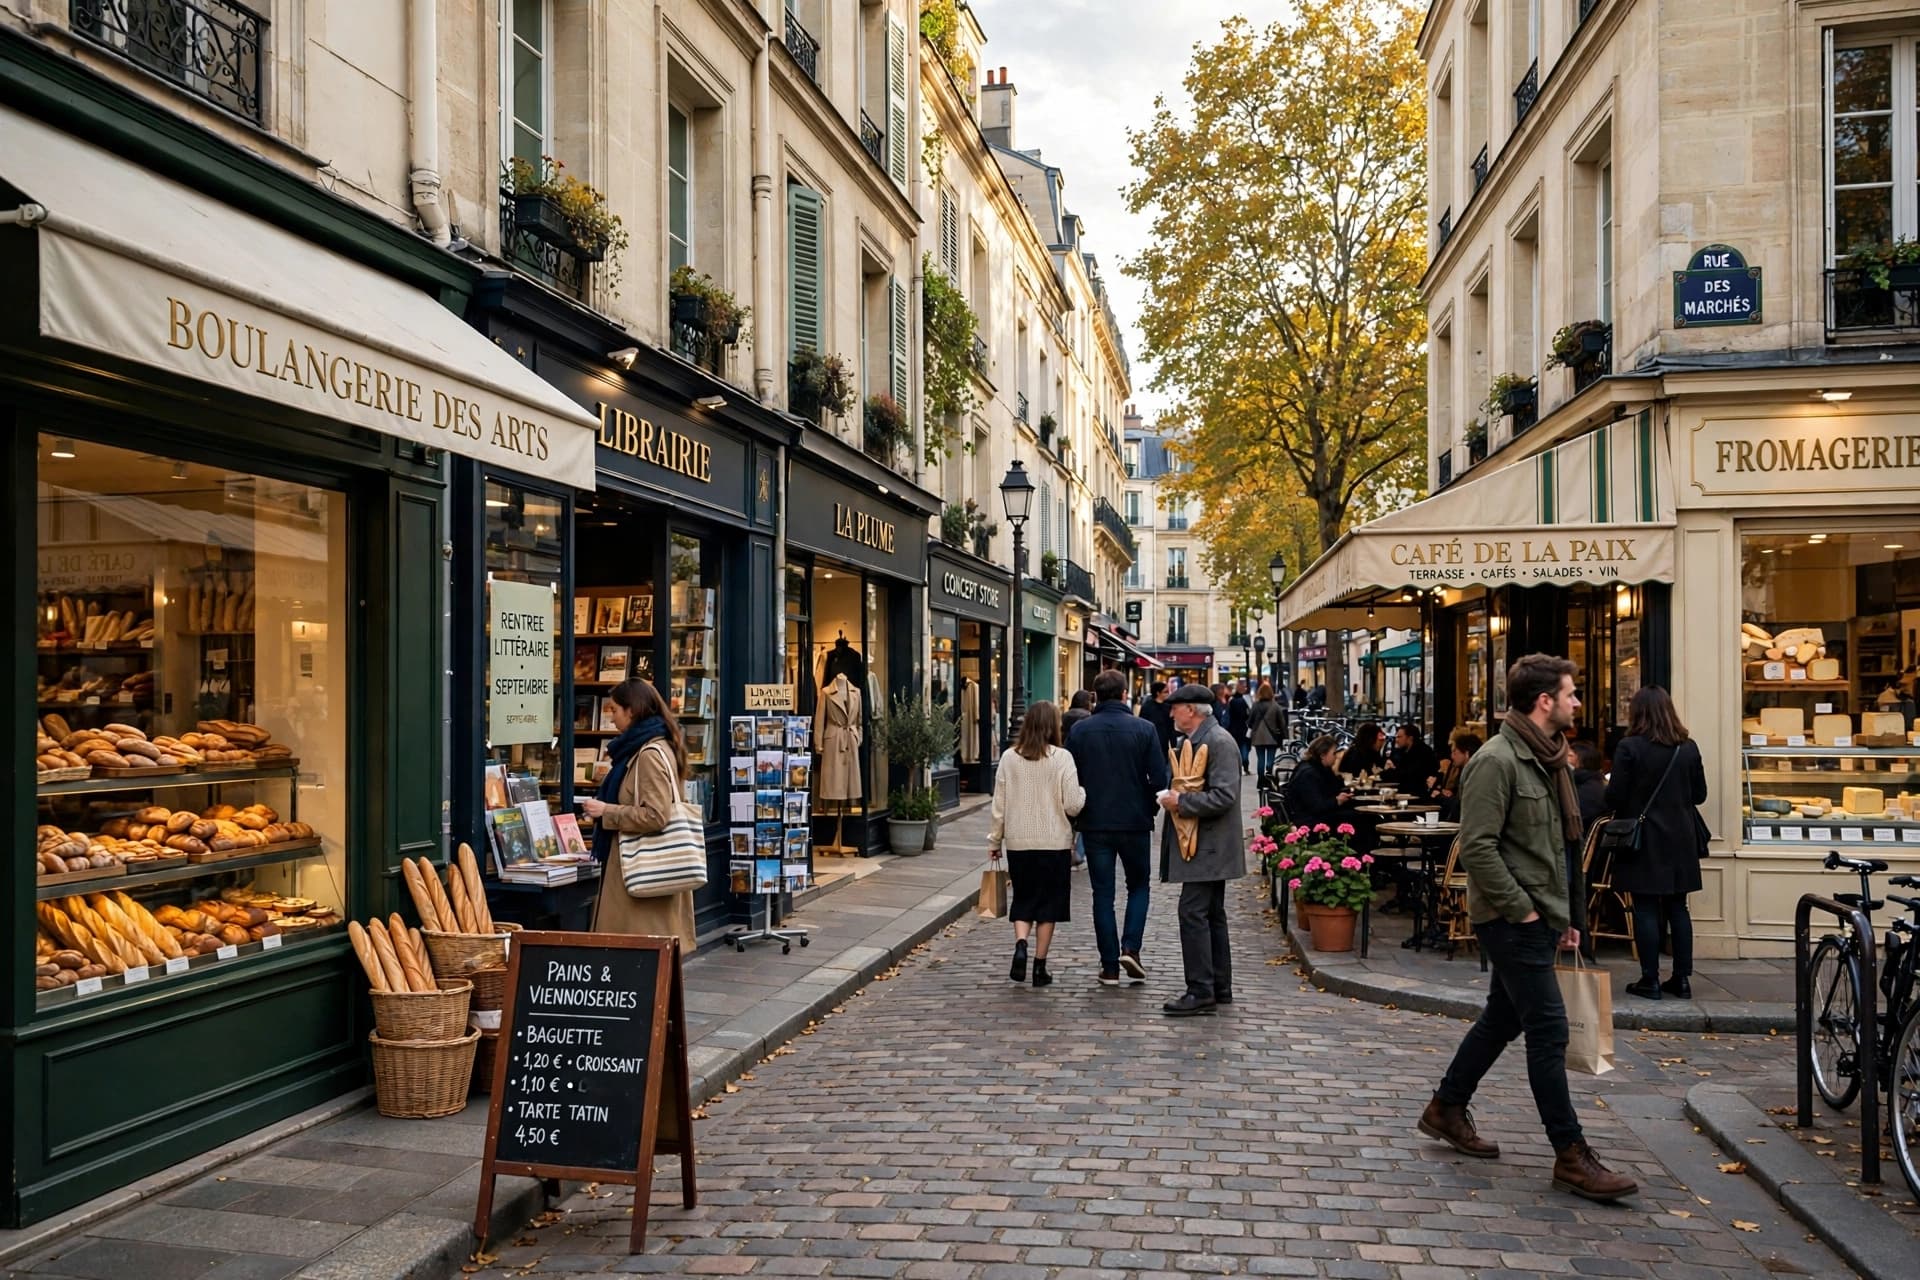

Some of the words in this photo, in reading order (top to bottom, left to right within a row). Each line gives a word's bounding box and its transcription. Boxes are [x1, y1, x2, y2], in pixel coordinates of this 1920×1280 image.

[1703, 253, 1730, 268] RUE
[1704, 279, 1731, 293] DES
[1684, 295, 1751, 316] MARCHÉS
[166, 297, 423, 422] BOULANGERIE
[432, 389, 482, 440] DES
[491, 410, 550, 462] ARTS
[597, 401, 712, 483] LIBRAIRIE
[1715, 435, 1920, 473] FROMAGERIE
[835, 502, 853, 540] LA
[856, 511, 895, 554] PLUME
[1391, 537, 1464, 566] CAFÉ
[1473, 541, 1513, 564] DE
[1522, 540, 1561, 563] LA
[1569, 538, 1638, 562] PAIX
[1409, 568, 1465, 580] TERRASSE
[1481, 565, 1516, 579] CAFÉS
[1532, 566, 1583, 578] SALADES
[1599, 565, 1619, 577] VIN
[943, 571, 978, 601] CONCEPT
[979, 584, 999, 609] STORE
[501, 611, 545, 632] RENTREE
[494, 634, 550, 658] LITTÉRAIRE
[495, 678, 549, 695] SEPTEMBRE
[547, 960, 592, 983] PAINS
[600, 965, 612, 983] &
[529, 985, 638, 1010] VIENNOISERIES
[526, 1025, 604, 1046] BAGUETTE
[523, 1053, 550, 1070] 1,20
[552, 1053, 563, 1069] €
[576, 1055, 644, 1075] CROISSANT
[520, 1075, 545, 1094] 1,10
[550, 1077, 560, 1093] €
[517, 1101, 562, 1120] TARTE
[568, 1103, 609, 1123] TATIN
[514, 1124, 546, 1147] 4,50
[550, 1129, 561, 1146] €
